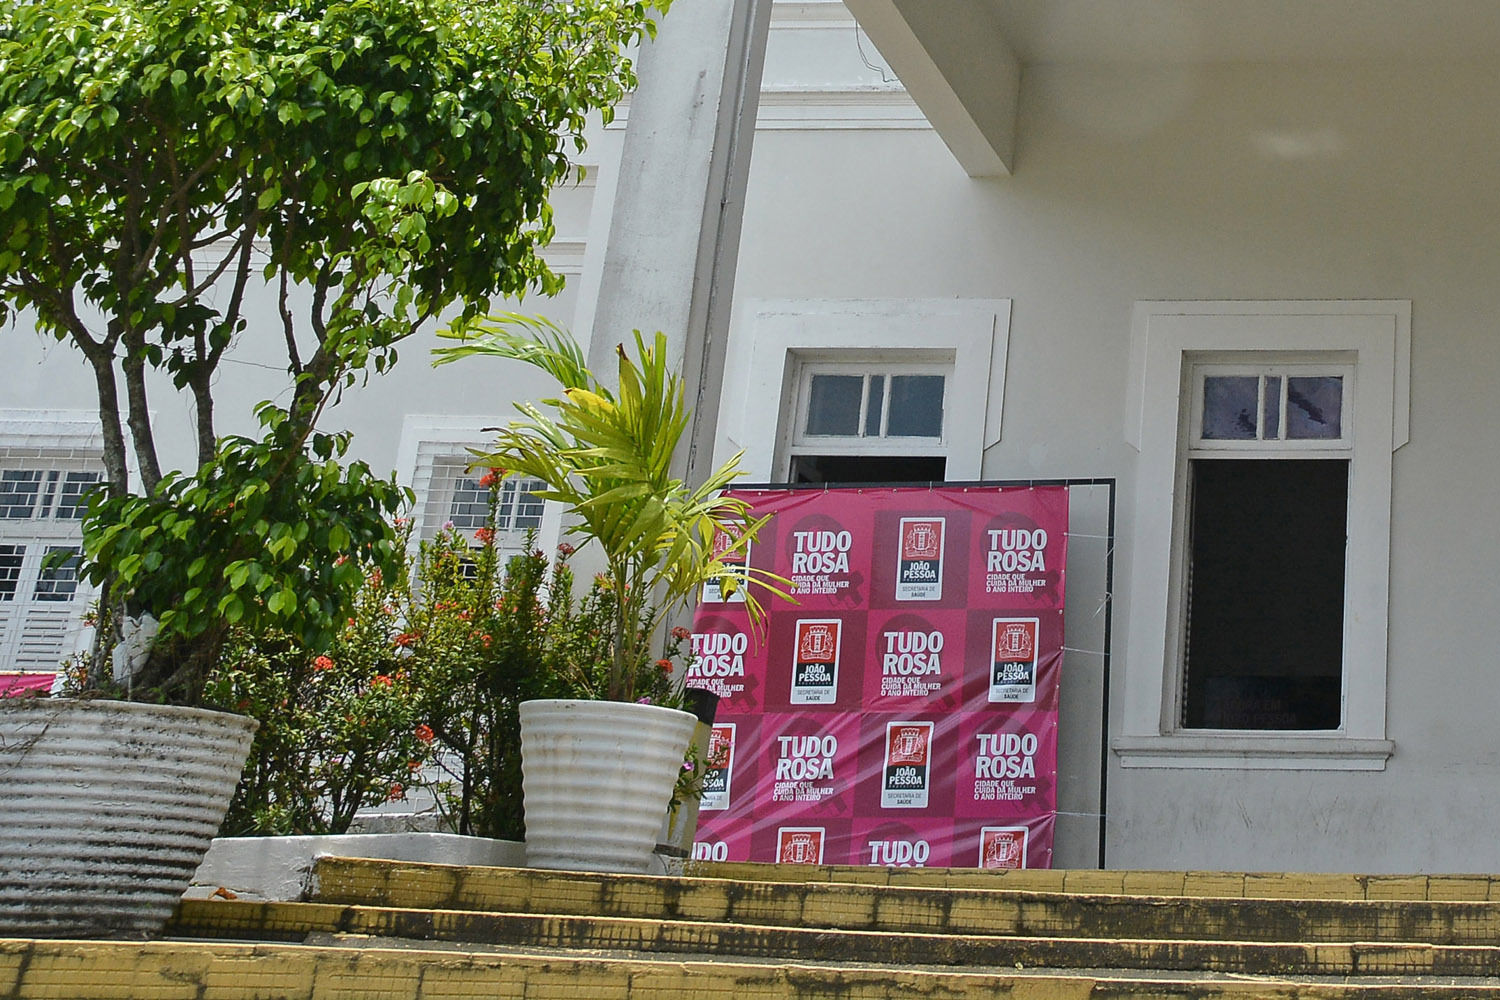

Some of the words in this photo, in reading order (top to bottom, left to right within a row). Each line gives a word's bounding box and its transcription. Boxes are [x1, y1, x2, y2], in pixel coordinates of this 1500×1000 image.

[794, 531, 851, 552] TUDO
[988, 529, 1047, 551] TUDO
[792, 553, 849, 573] ROSA
[910, 561, 930, 570] JOÃO
[987, 551, 1045, 572] ROSA
[904, 570, 936, 579] PESSOA
[691, 633, 748, 655] TUDO
[884, 631, 944, 653] TUDO
[688, 655, 744, 677] ROSA
[805, 663, 825, 673] JOÃO
[883, 654, 941, 675] ROSA
[1003, 662, 1024, 672] JOÃO
[799, 673, 831, 681] PESSOA
[997, 672, 1029, 680] PESSOA
[778, 735, 837, 758] TUDO
[976, 733, 1038, 756] TUDO
[776, 759, 834, 780] ROSA
[895, 766, 916, 776] JOÃO
[975, 756, 1035, 779] ROSA
[889, 776, 922, 784] PESSOA
[869, 840, 930, 863] TUDO
